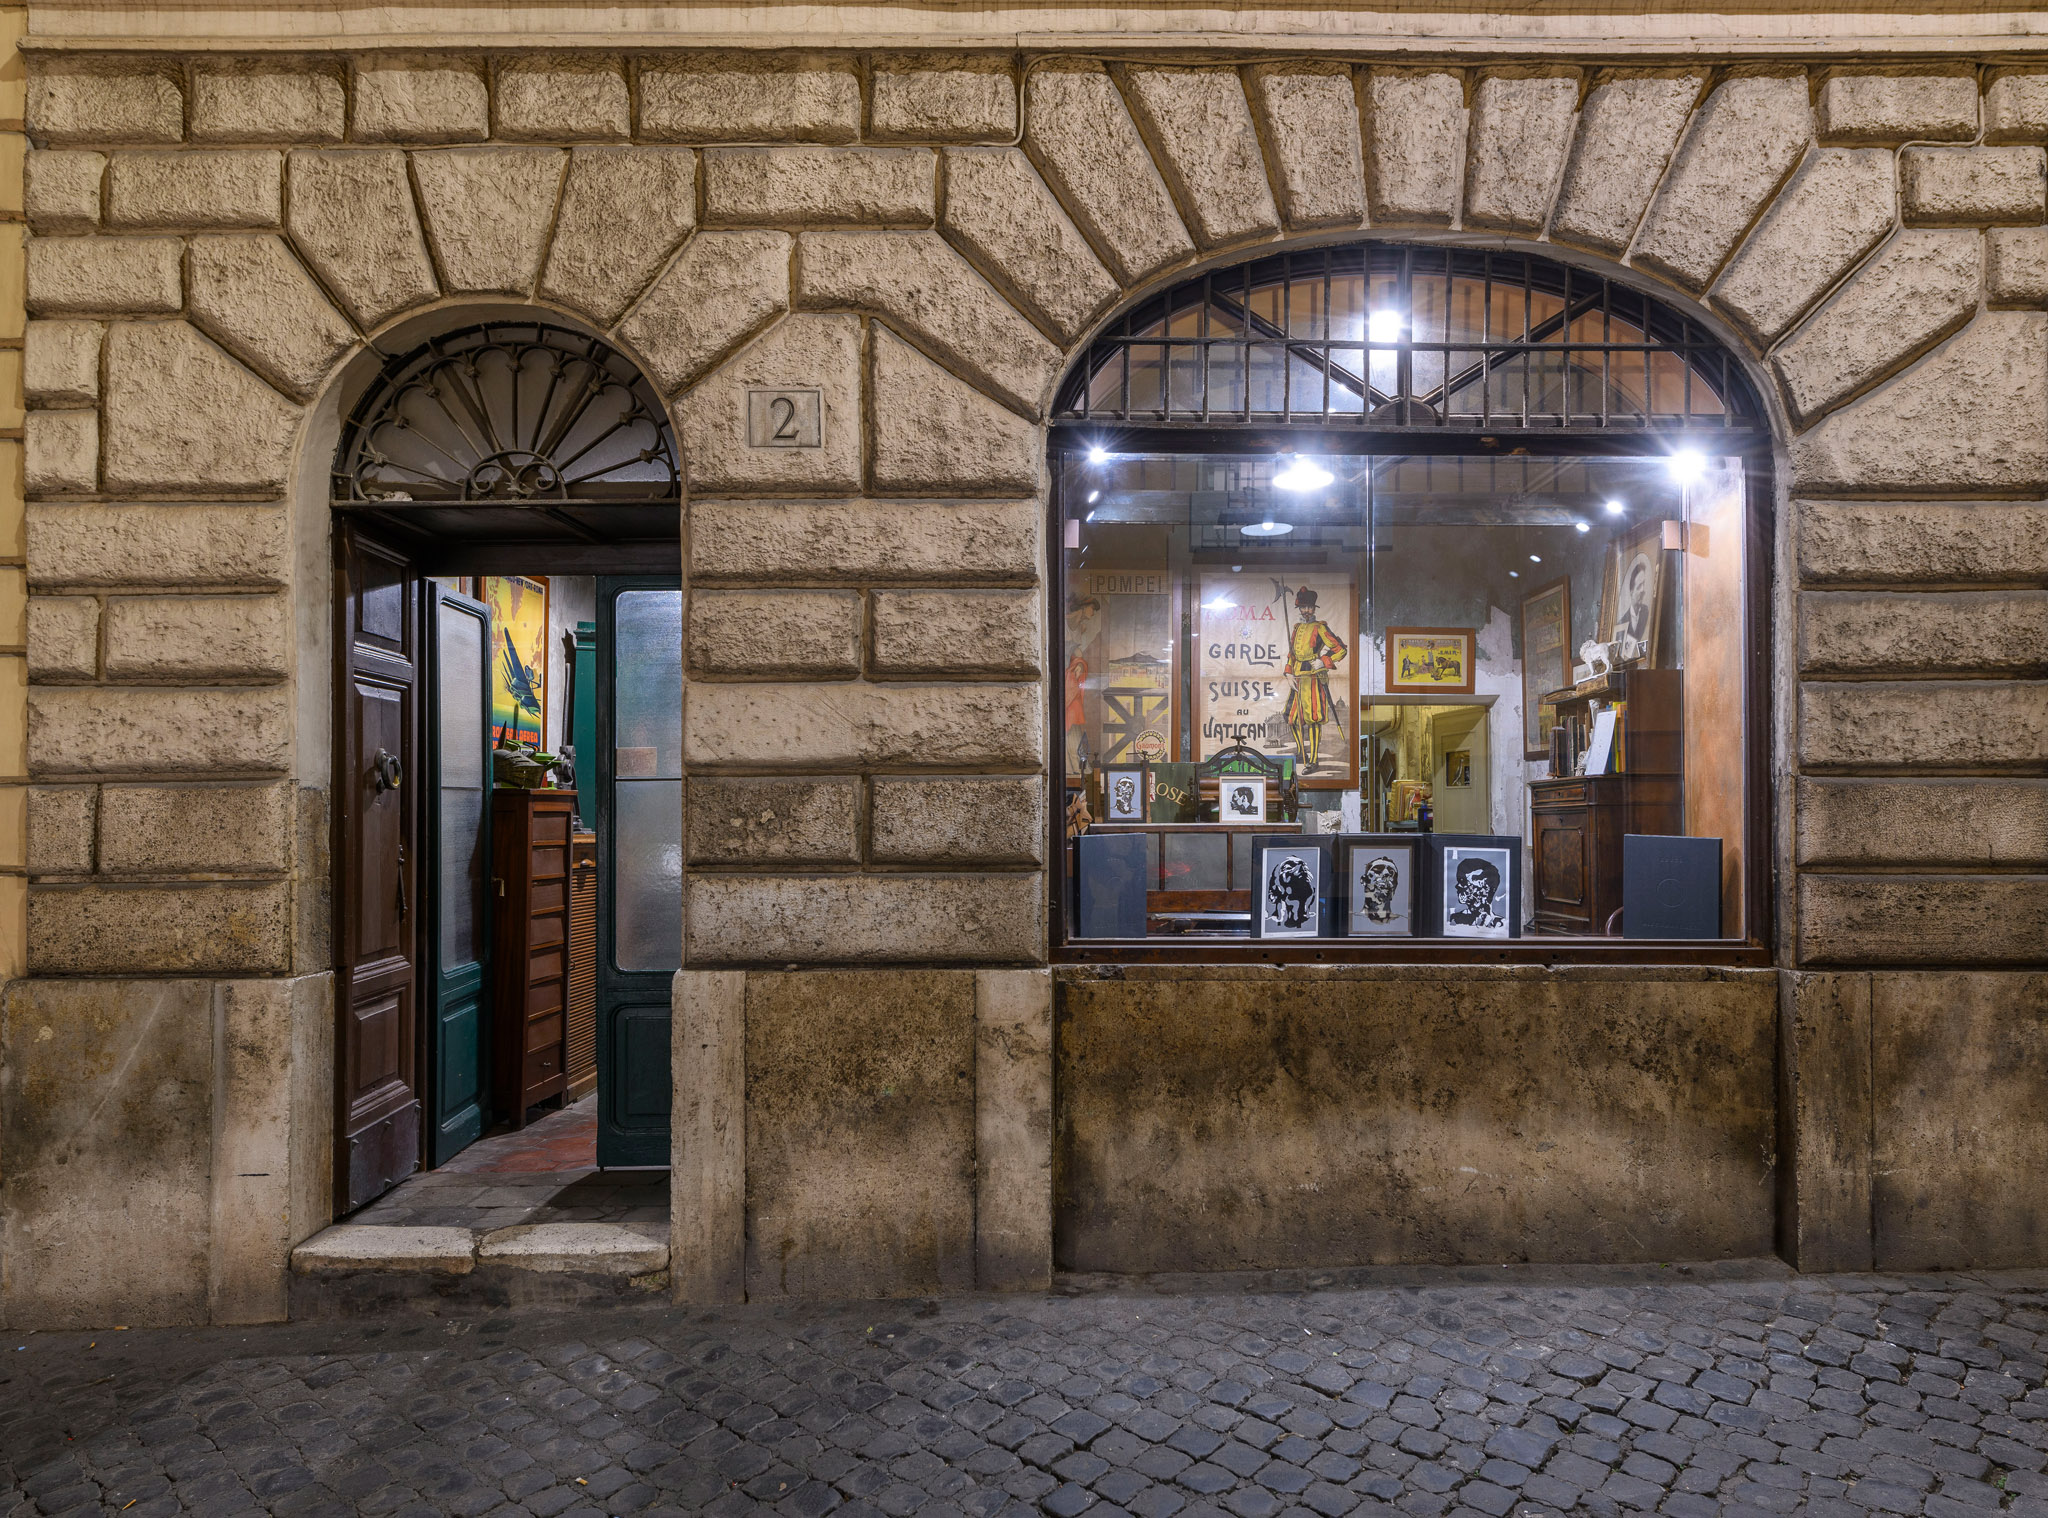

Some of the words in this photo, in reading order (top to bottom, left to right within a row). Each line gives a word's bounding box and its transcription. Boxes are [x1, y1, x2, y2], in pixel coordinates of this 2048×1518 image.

[770, 397, 799, 440] 2
[1096, 575, 1162, 593] POMPEI
[1209, 643, 1281, 668] GARDE
[1209, 680, 1276, 702] SUISSE
[1236, 708, 1249, 716] AU
[1203, 716, 1267, 746] VATICAN
